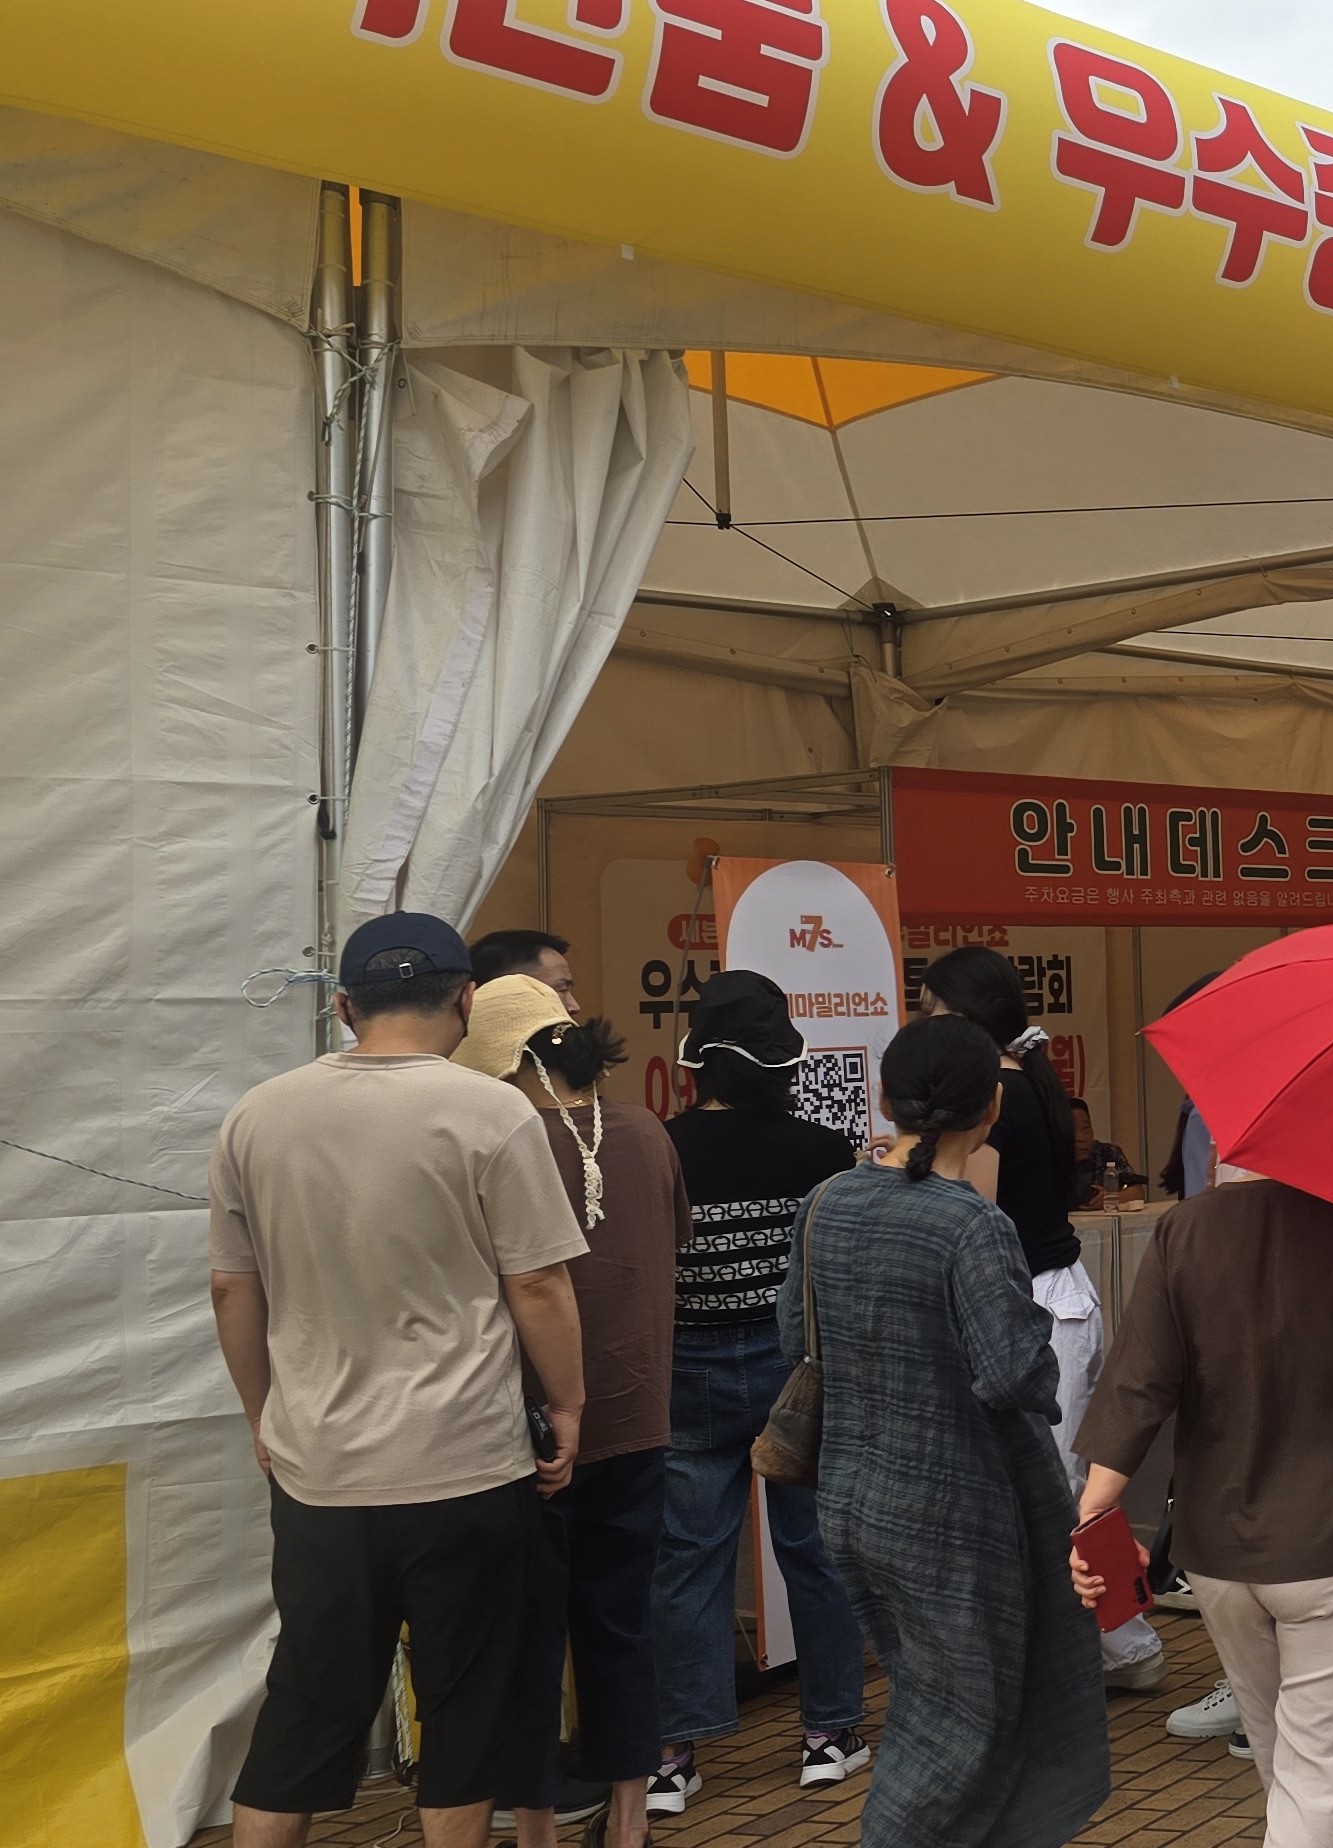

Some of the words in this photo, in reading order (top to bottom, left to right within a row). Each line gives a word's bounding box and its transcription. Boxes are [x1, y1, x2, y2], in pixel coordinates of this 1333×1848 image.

[1024, 886, 1100, 905] 주차요금은
[1106, 887, 1135, 906] 행사
[1140, 888, 1196, 907] 주최측과
[1201, 890, 1228, 908] 관련
[1233, 891, 1271, 908] 없음을
[1006, 954, 1073, 1016] 람회
[786, 992, 889, 1018] 마밀리언쇼
